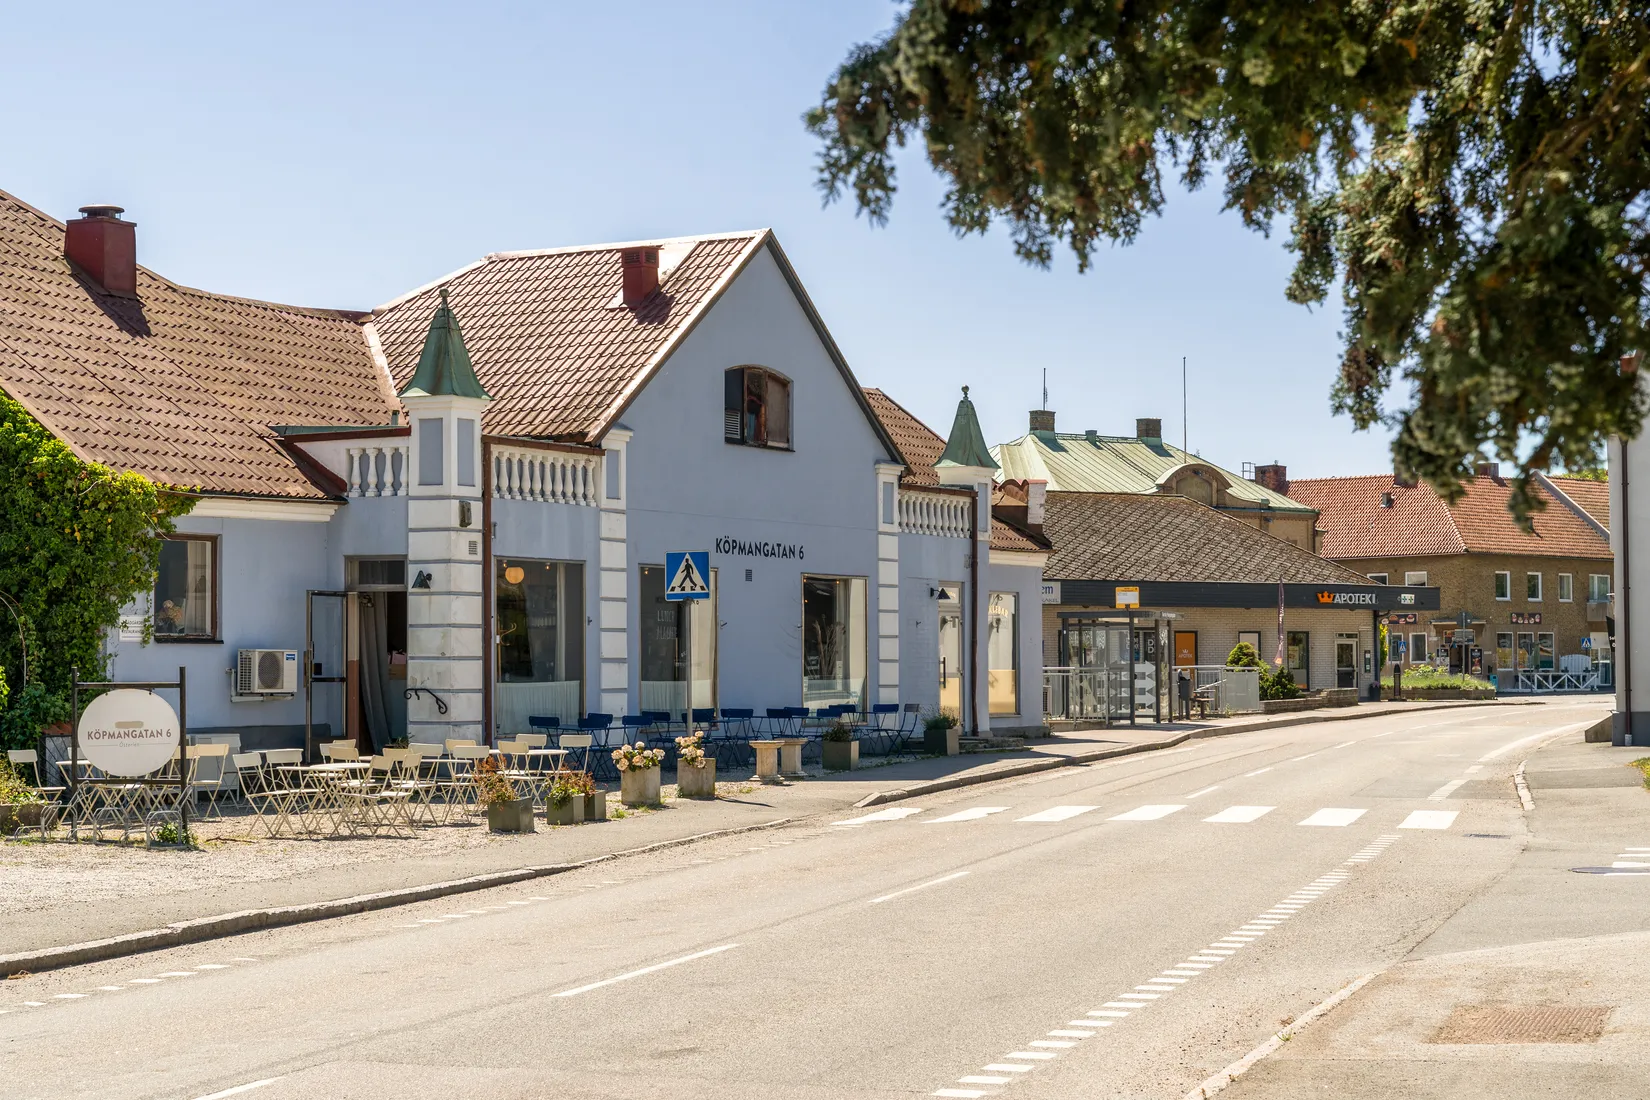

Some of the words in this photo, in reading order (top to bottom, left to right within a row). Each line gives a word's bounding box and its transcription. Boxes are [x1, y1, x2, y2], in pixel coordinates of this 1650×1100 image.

[715, 535, 796, 559] KÖPMANGATAN
[798, 545, 805, 560] 6
[87, 728, 163, 740] KÖPMANGATAN
[166, 728, 172, 738] 6
